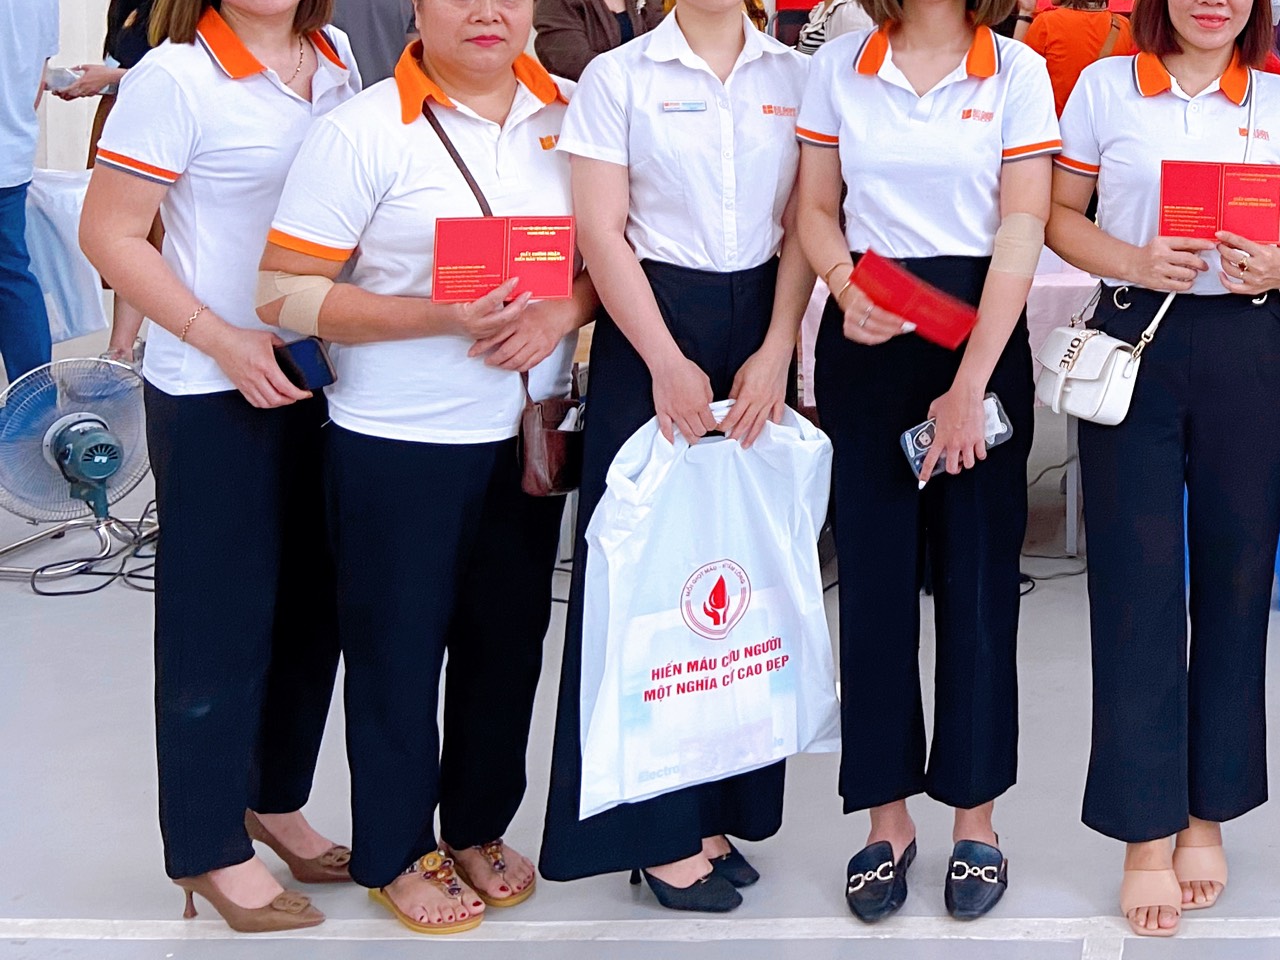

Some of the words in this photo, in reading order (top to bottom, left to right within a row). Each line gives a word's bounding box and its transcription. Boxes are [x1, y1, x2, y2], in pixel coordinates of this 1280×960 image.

[651, 659, 682, 681] HIẾN
[686, 656, 718, 674] MÁU
[744, 636, 782, 659] NGƯỜI
[643, 685, 673, 703] MỘT
[676, 676, 718, 695] NGHĨA
[737, 663, 763, 680] CAO
